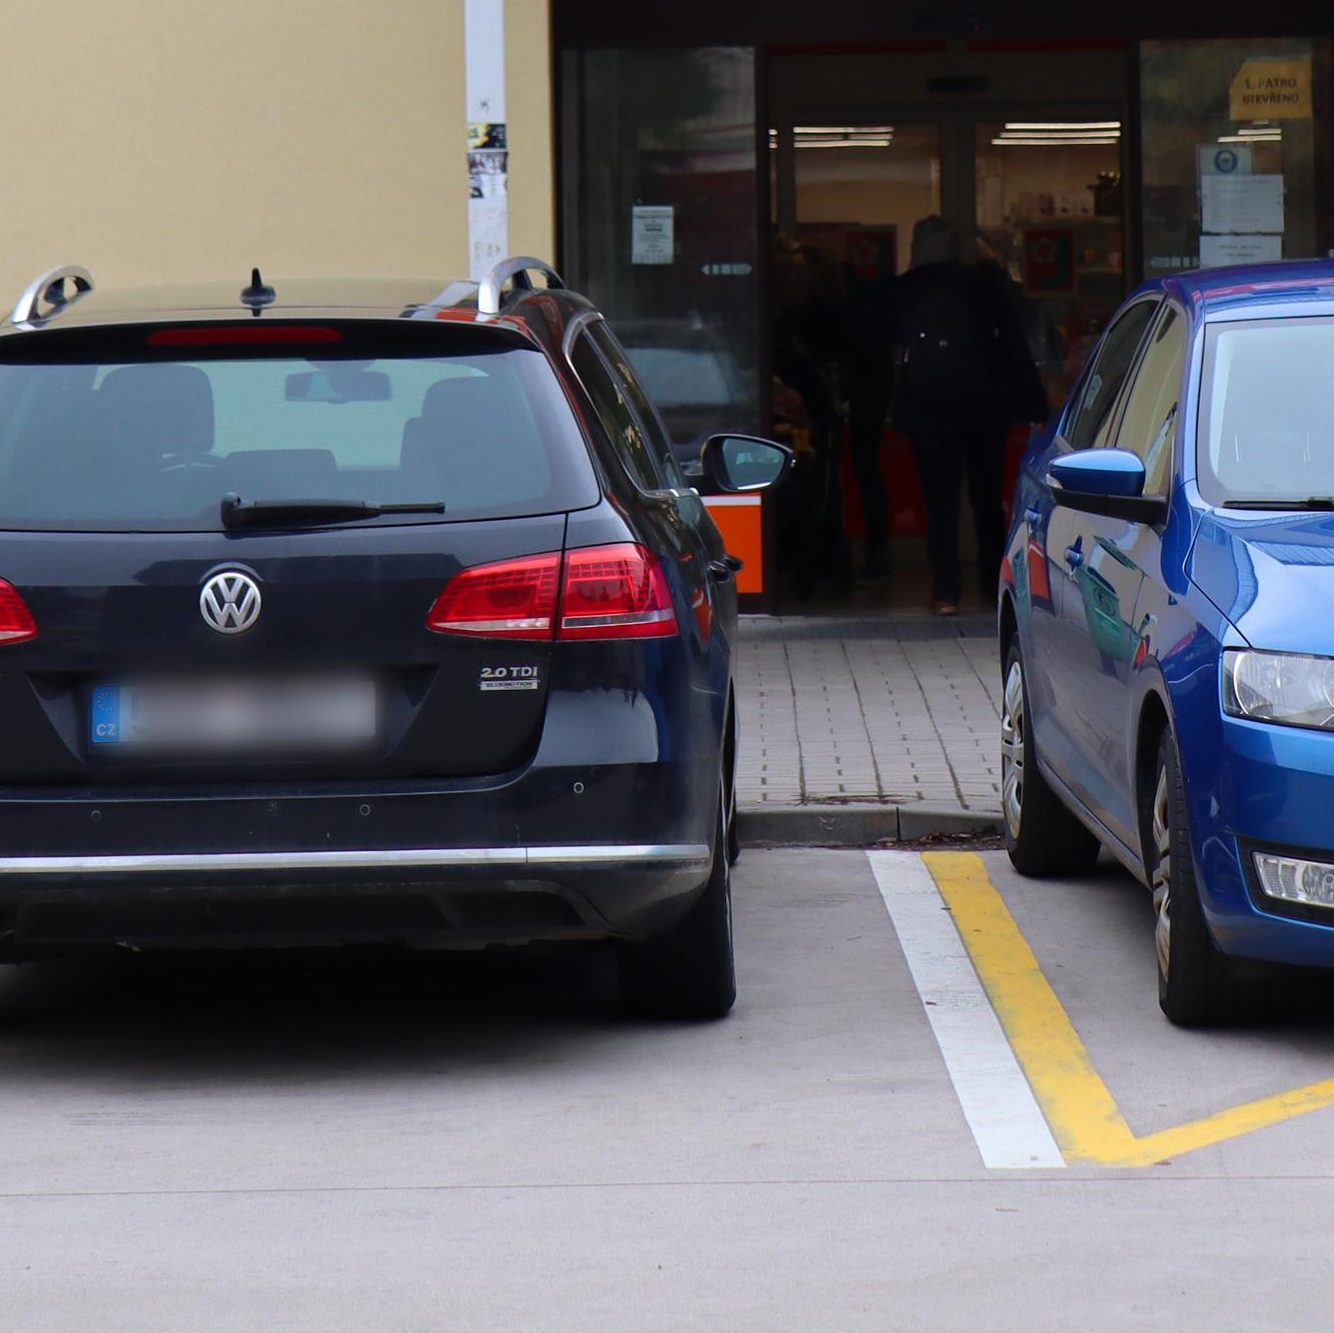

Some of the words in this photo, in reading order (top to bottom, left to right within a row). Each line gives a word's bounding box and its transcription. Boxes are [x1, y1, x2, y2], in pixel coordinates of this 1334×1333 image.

[1242, 90, 1300, 104] OTEVŘENO
[509, 666, 539, 677] TDI
[95, 723, 117, 740] CZ
